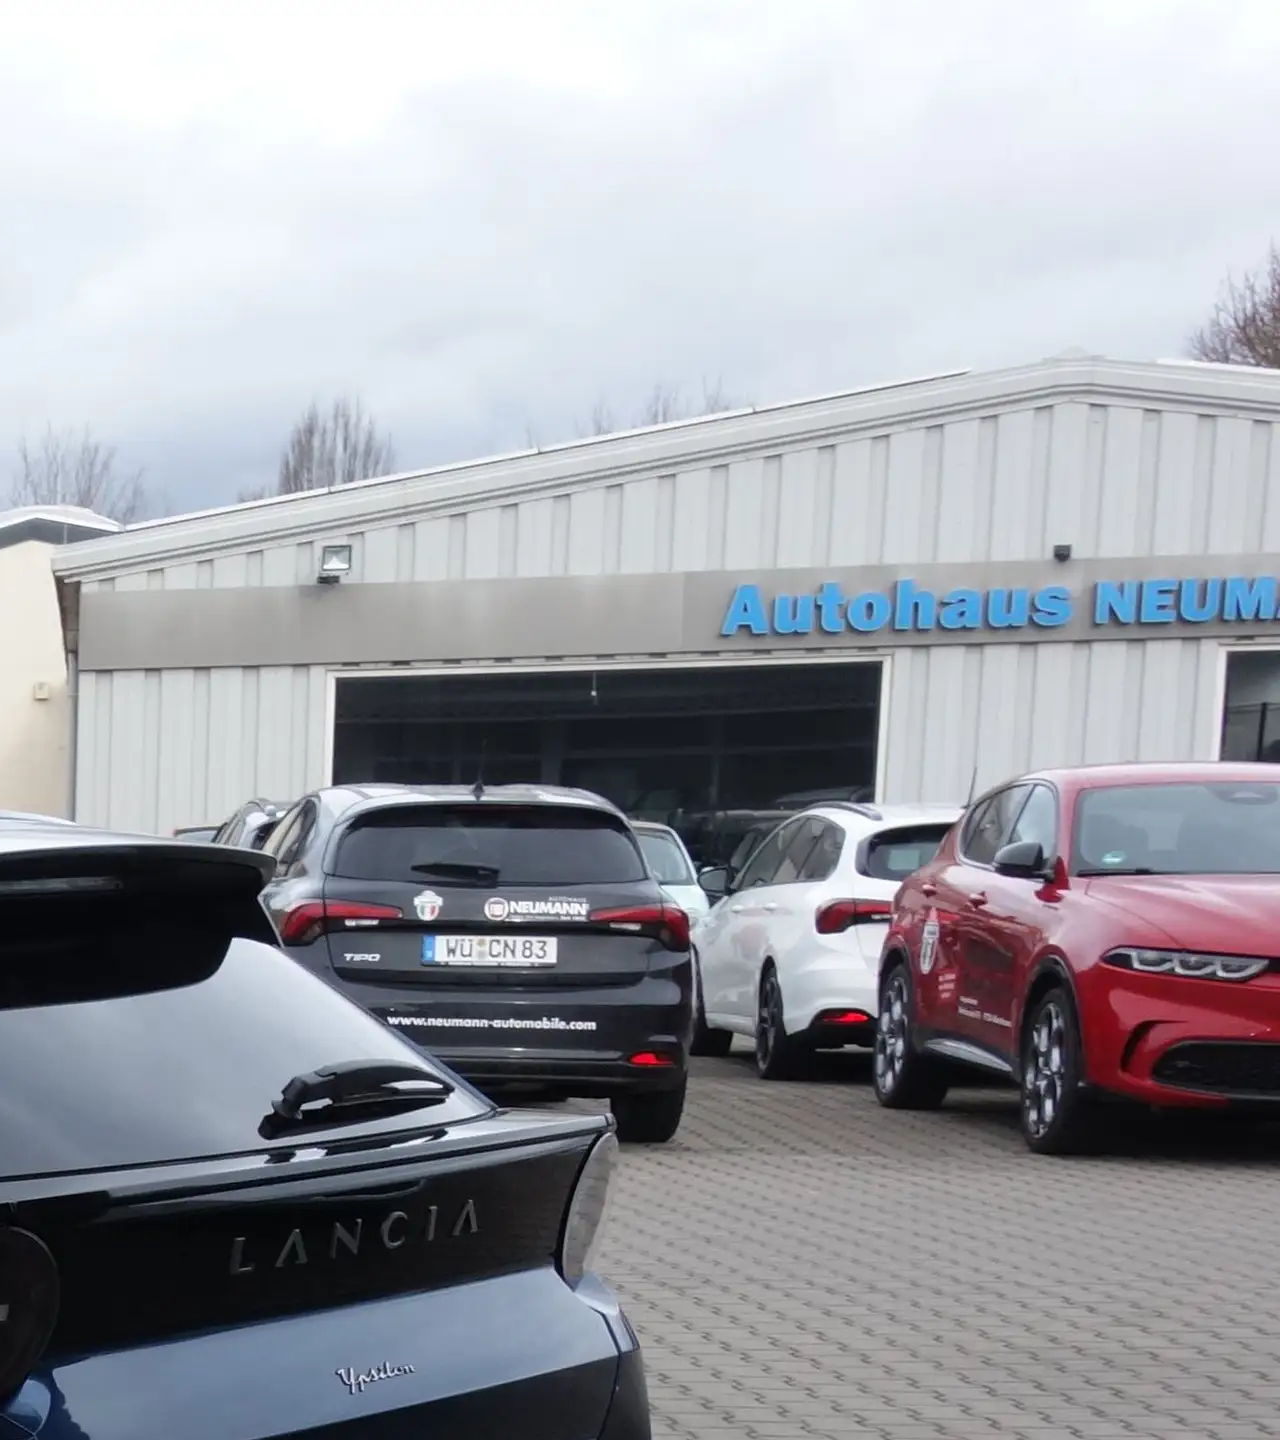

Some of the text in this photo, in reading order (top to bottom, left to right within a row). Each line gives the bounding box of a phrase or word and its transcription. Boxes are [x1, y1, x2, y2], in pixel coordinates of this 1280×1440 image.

[719, 576, 1280, 637] Autohaus NEUM
[510, 901, 588, 914] NEUMANN
[344, 953, 381, 961] TIPO
[446, 939, 547, 959] WÜ CN 83
[387, 1015, 597, 1031] www.neumann-automobile.com
[230, 1199, 479, 1274] LANCIA
[336, 1361, 417, 1395] Ypsilon
